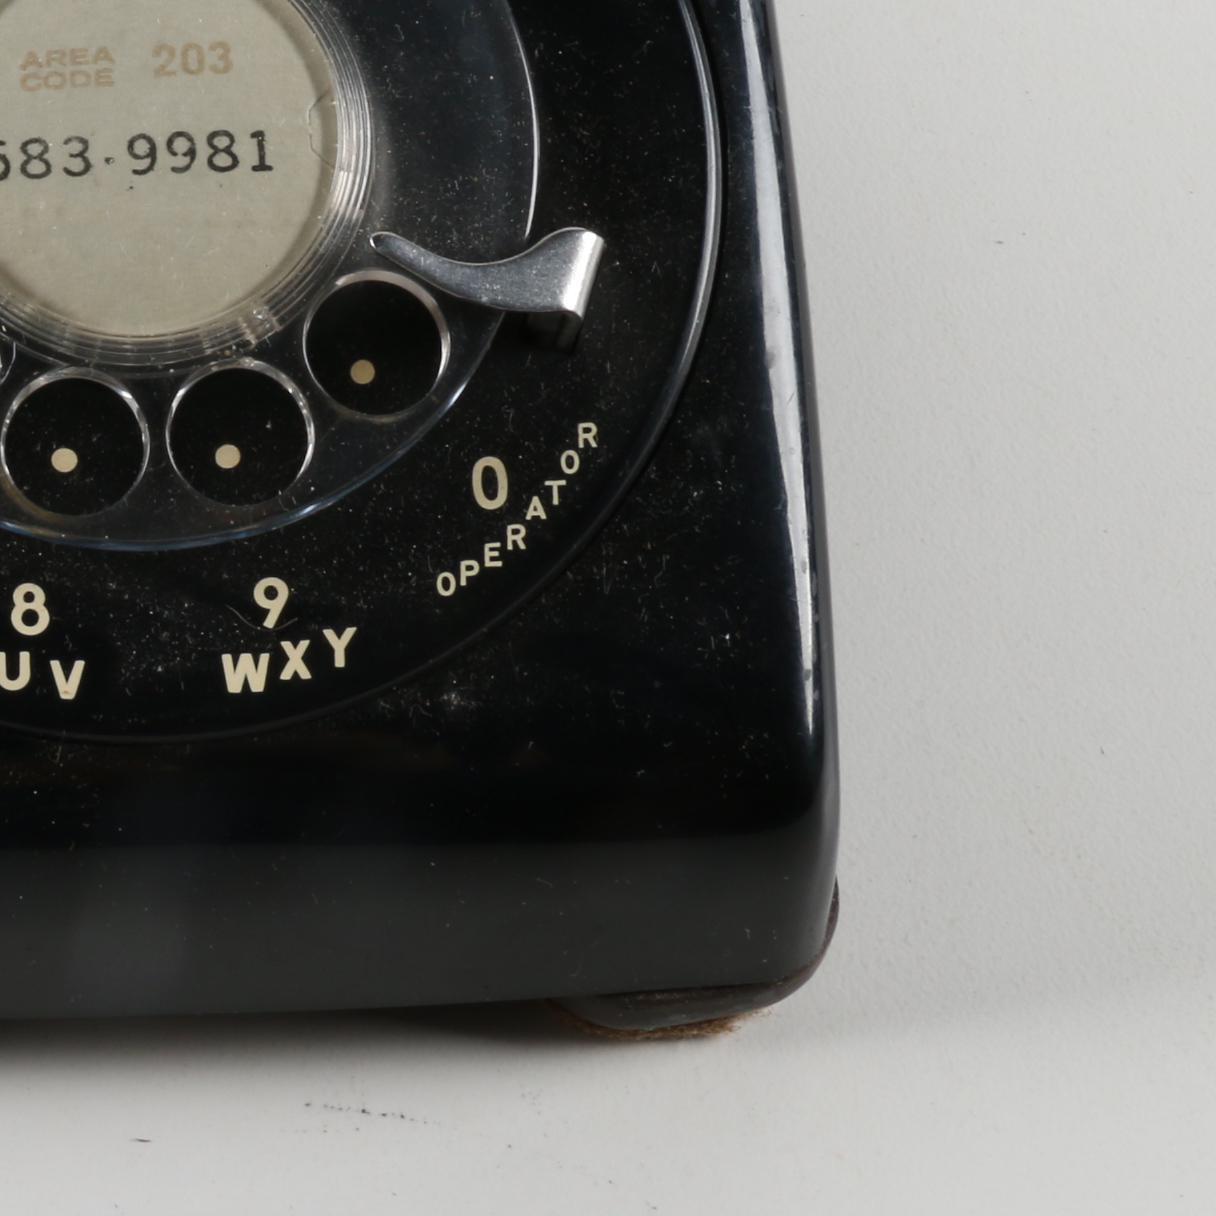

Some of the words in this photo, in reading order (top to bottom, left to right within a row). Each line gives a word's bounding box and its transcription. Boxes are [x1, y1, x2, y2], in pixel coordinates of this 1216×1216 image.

[20, 46, 115, 71] AREA
[152, 41, 233, 77] 203
[20, 67, 115, 92] CODE
[436, 422, 598, 597] OPERATOR
[10, 582, 50, 636] 8
[253, 577, 290, 630] 9
[221, 627, 357, 695] WXY
